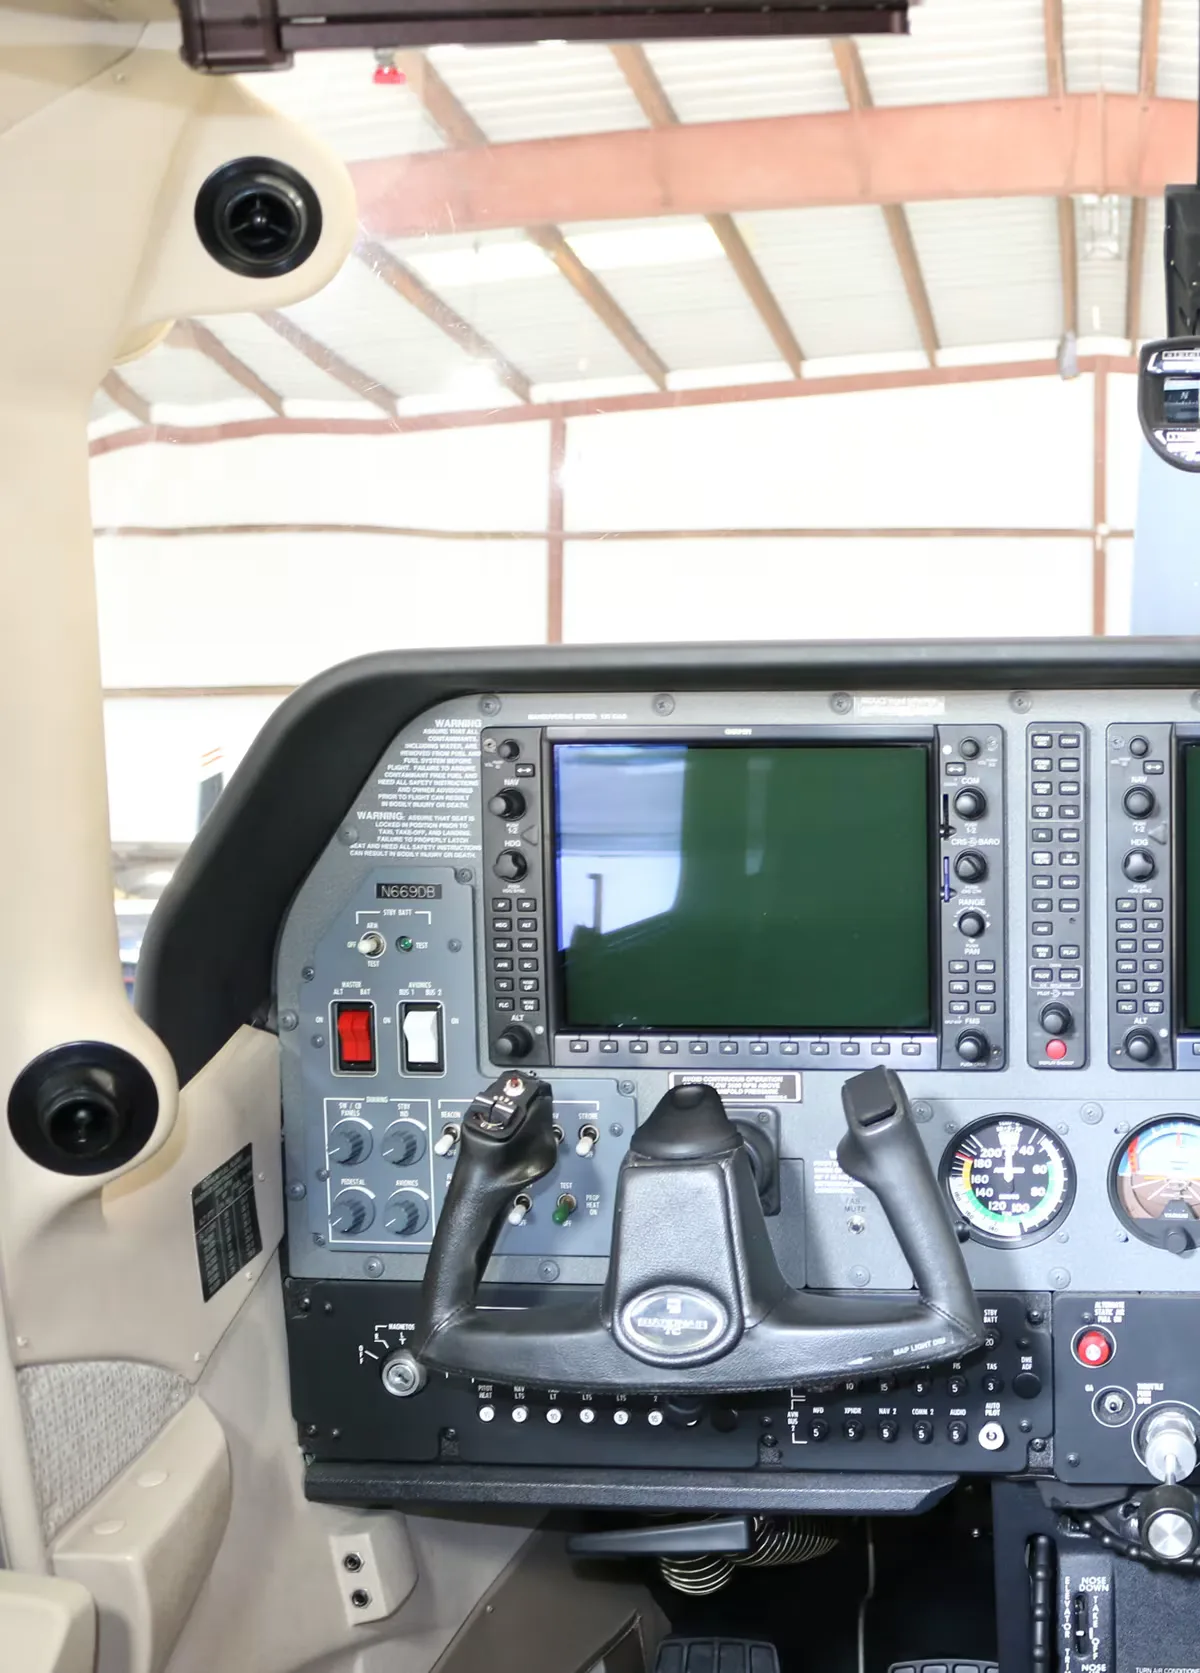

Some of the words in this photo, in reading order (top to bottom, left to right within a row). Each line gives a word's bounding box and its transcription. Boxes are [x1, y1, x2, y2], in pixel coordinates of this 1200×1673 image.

[1180, 391, 1189, 399] N
[435, 719, 482, 728] WARNING
[382, 885, 436, 898] N669DB
[1019, 1146, 1034, 1155] 40
[974, 1159, 992, 1168] 180
[1032, 1165, 1047, 1174] 60
[971, 1175, 989, 1184] 160
[976, 1188, 993, 1197] 140
[1030, 1187, 1046, 1197] 80
[844, 1205, 866, 1213] MUTE
[988, 1201, 1006, 1210] 120
[1012, 1203, 1030, 1213] 100
[984, 1315, 998, 1323] BATT
[388, 1323, 415, 1331] MAGNETOS
[985, 1338, 994, 1346] 20
[893, 1346, 909, 1357] MAP
[910, 1341, 932, 1352] LIGHT
[932, 1337, 946, 1348] DIM
[1021, 1356, 1032, 1364] DME
[846, 1383, 854, 1391] 10
[917, 1384, 923, 1392] 5
[952, 1384, 958, 1393] 5
[988, 1383, 994, 1391] 3
[515, 1392, 525, 1400] LTS
[985, 1402, 1000, 1410] AUTO
[929, 1408, 934, 1416] 2
[950, 1409, 966, 1417] AUDIO
[984, 1409, 1000, 1417] PILOT
[619, 1414, 623, 1422] 5
[813, 1429, 819, 1437] 5
[848, 1428, 855, 1437] 5
[883, 1428, 889, 1437] 5
[918, 1430, 925, 1439] 5
[952, 1430, 959, 1440] 5
[1079, 1584, 1109, 1592] DOWN
[1064, 1576, 1072, 1639] ELEVATOR
[1091, 1638, 1100, 1660] OFF
[1081, 1664, 1106, 1672] NOSE
